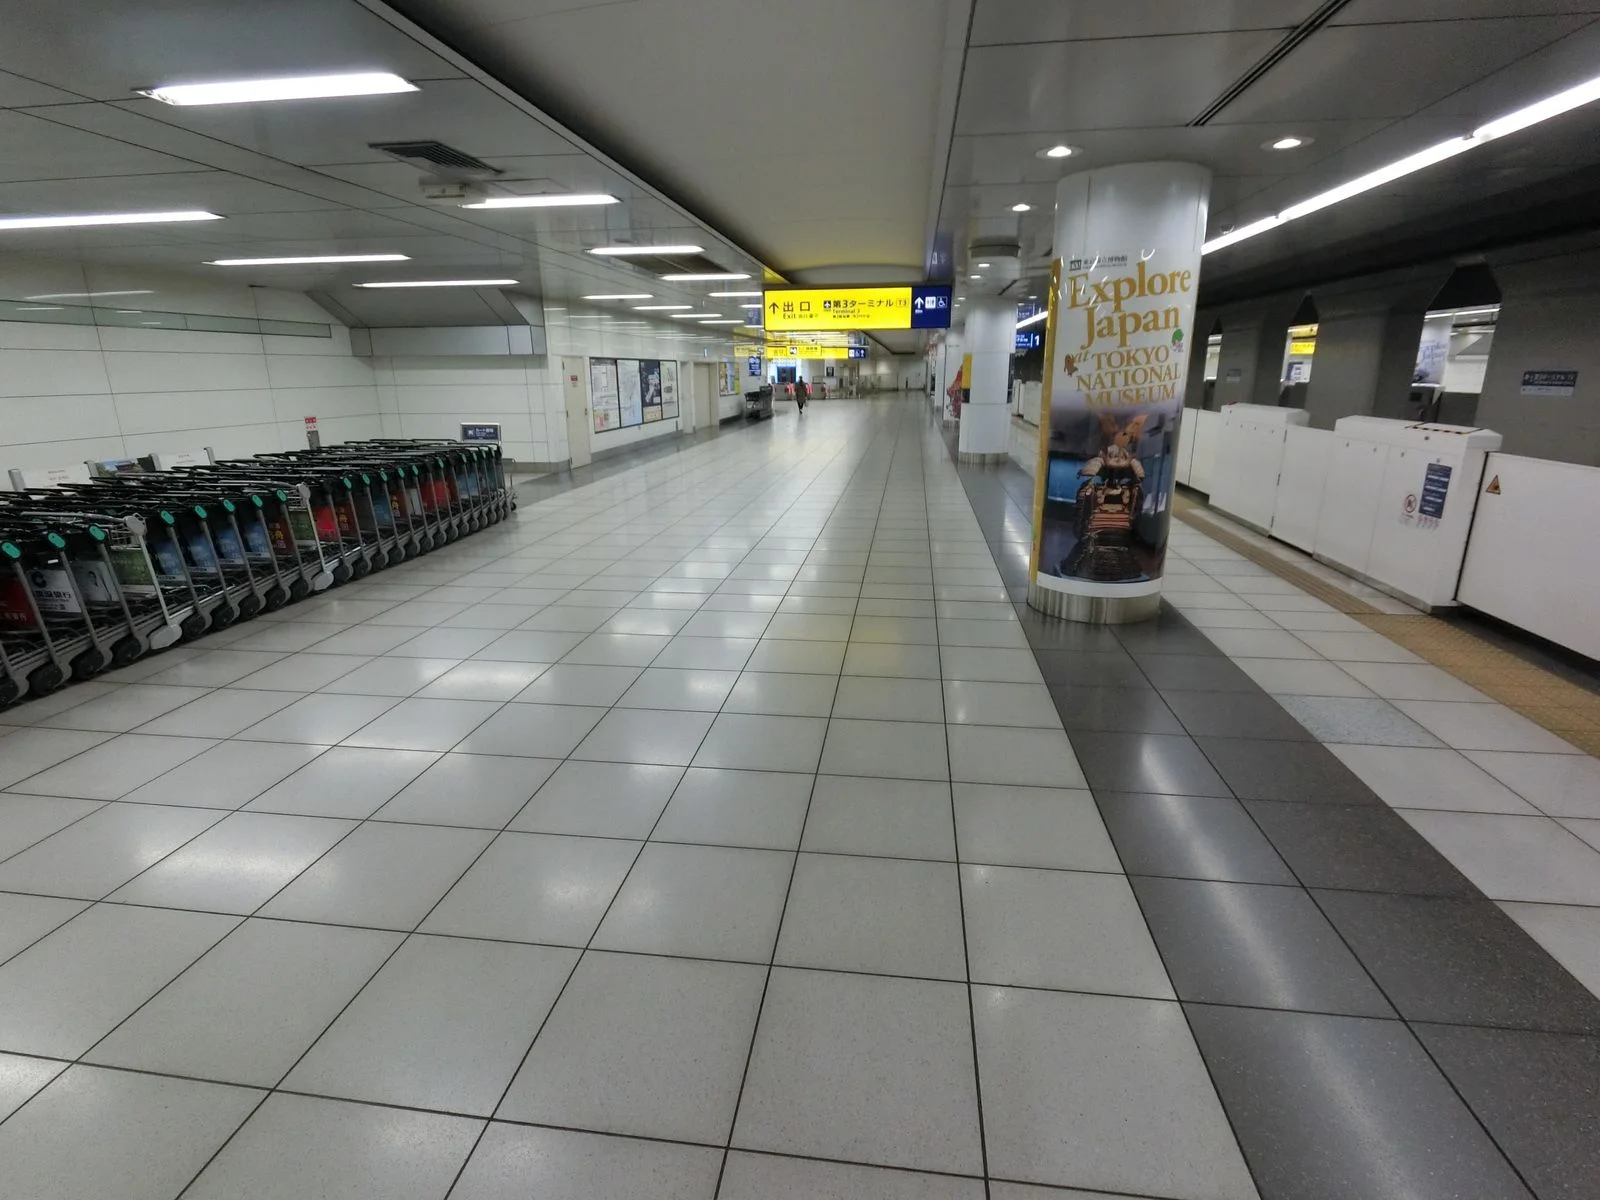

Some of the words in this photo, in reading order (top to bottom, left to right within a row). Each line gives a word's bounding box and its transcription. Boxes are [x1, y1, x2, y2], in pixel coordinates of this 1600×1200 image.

[1068, 261, 1192, 313] Explore
[783, 301, 811, 313] 出口
[832, 299, 894, 309] 第3ターミナル
[1034, 335, 1040, 346] 1
[1080, 305, 1182, 350] Japan
[1091, 344, 1170, 371] TOKYO
[1075, 363, 1182, 392] NATIONAL
[1085, 382, 1177, 409] MUSEUM
